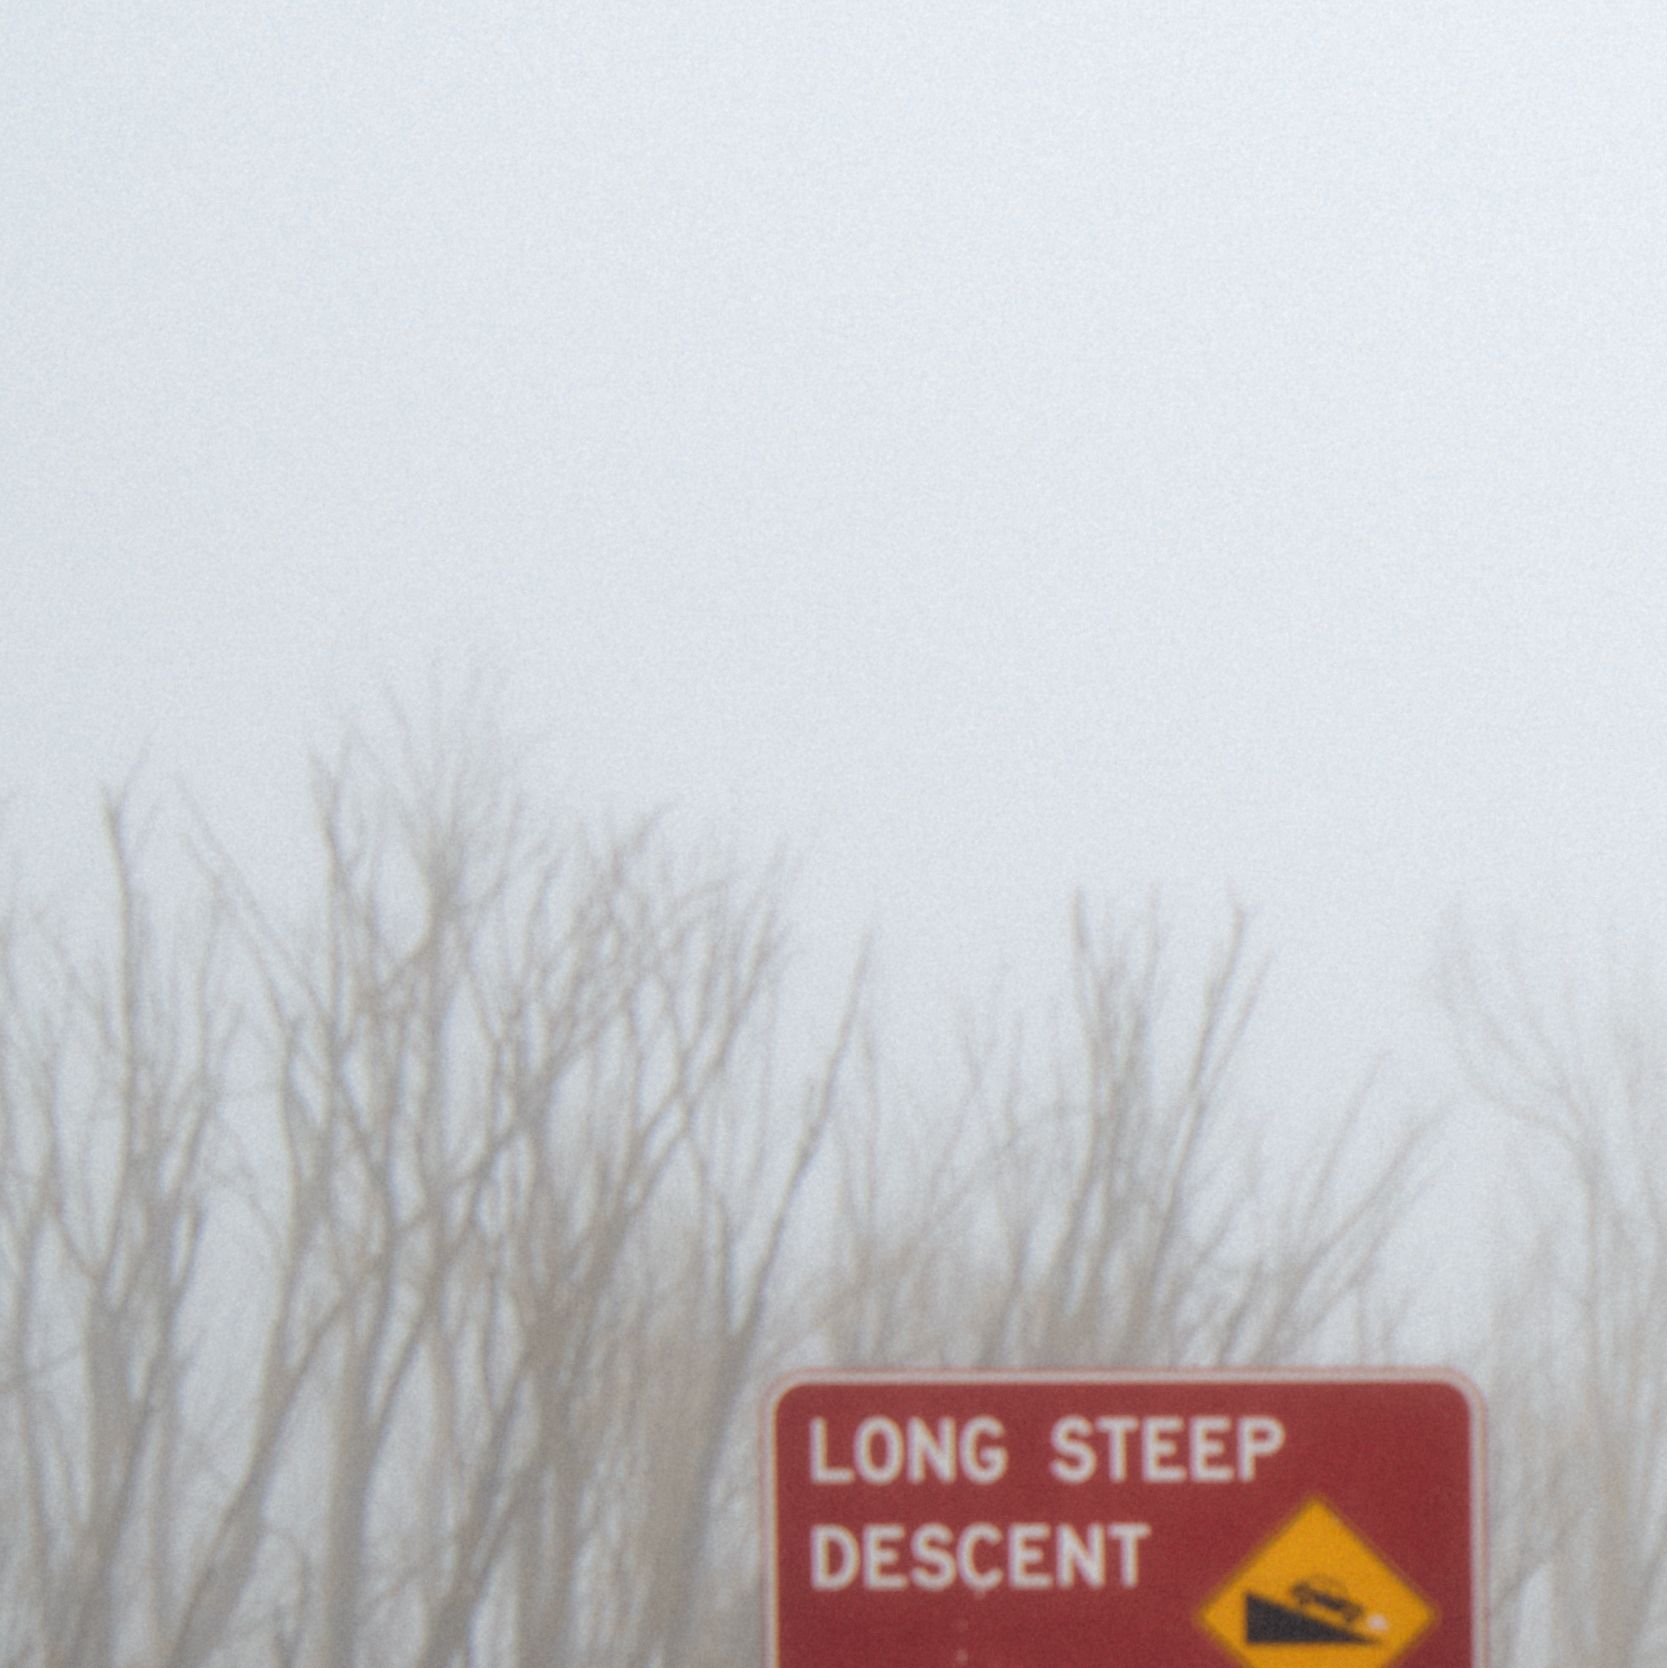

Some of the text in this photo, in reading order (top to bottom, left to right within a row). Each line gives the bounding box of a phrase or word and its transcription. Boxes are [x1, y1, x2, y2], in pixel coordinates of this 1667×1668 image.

[809, 1415, 1286, 1485] LONG STEEP
[810, 1522, 1151, 1592] DESCENT
